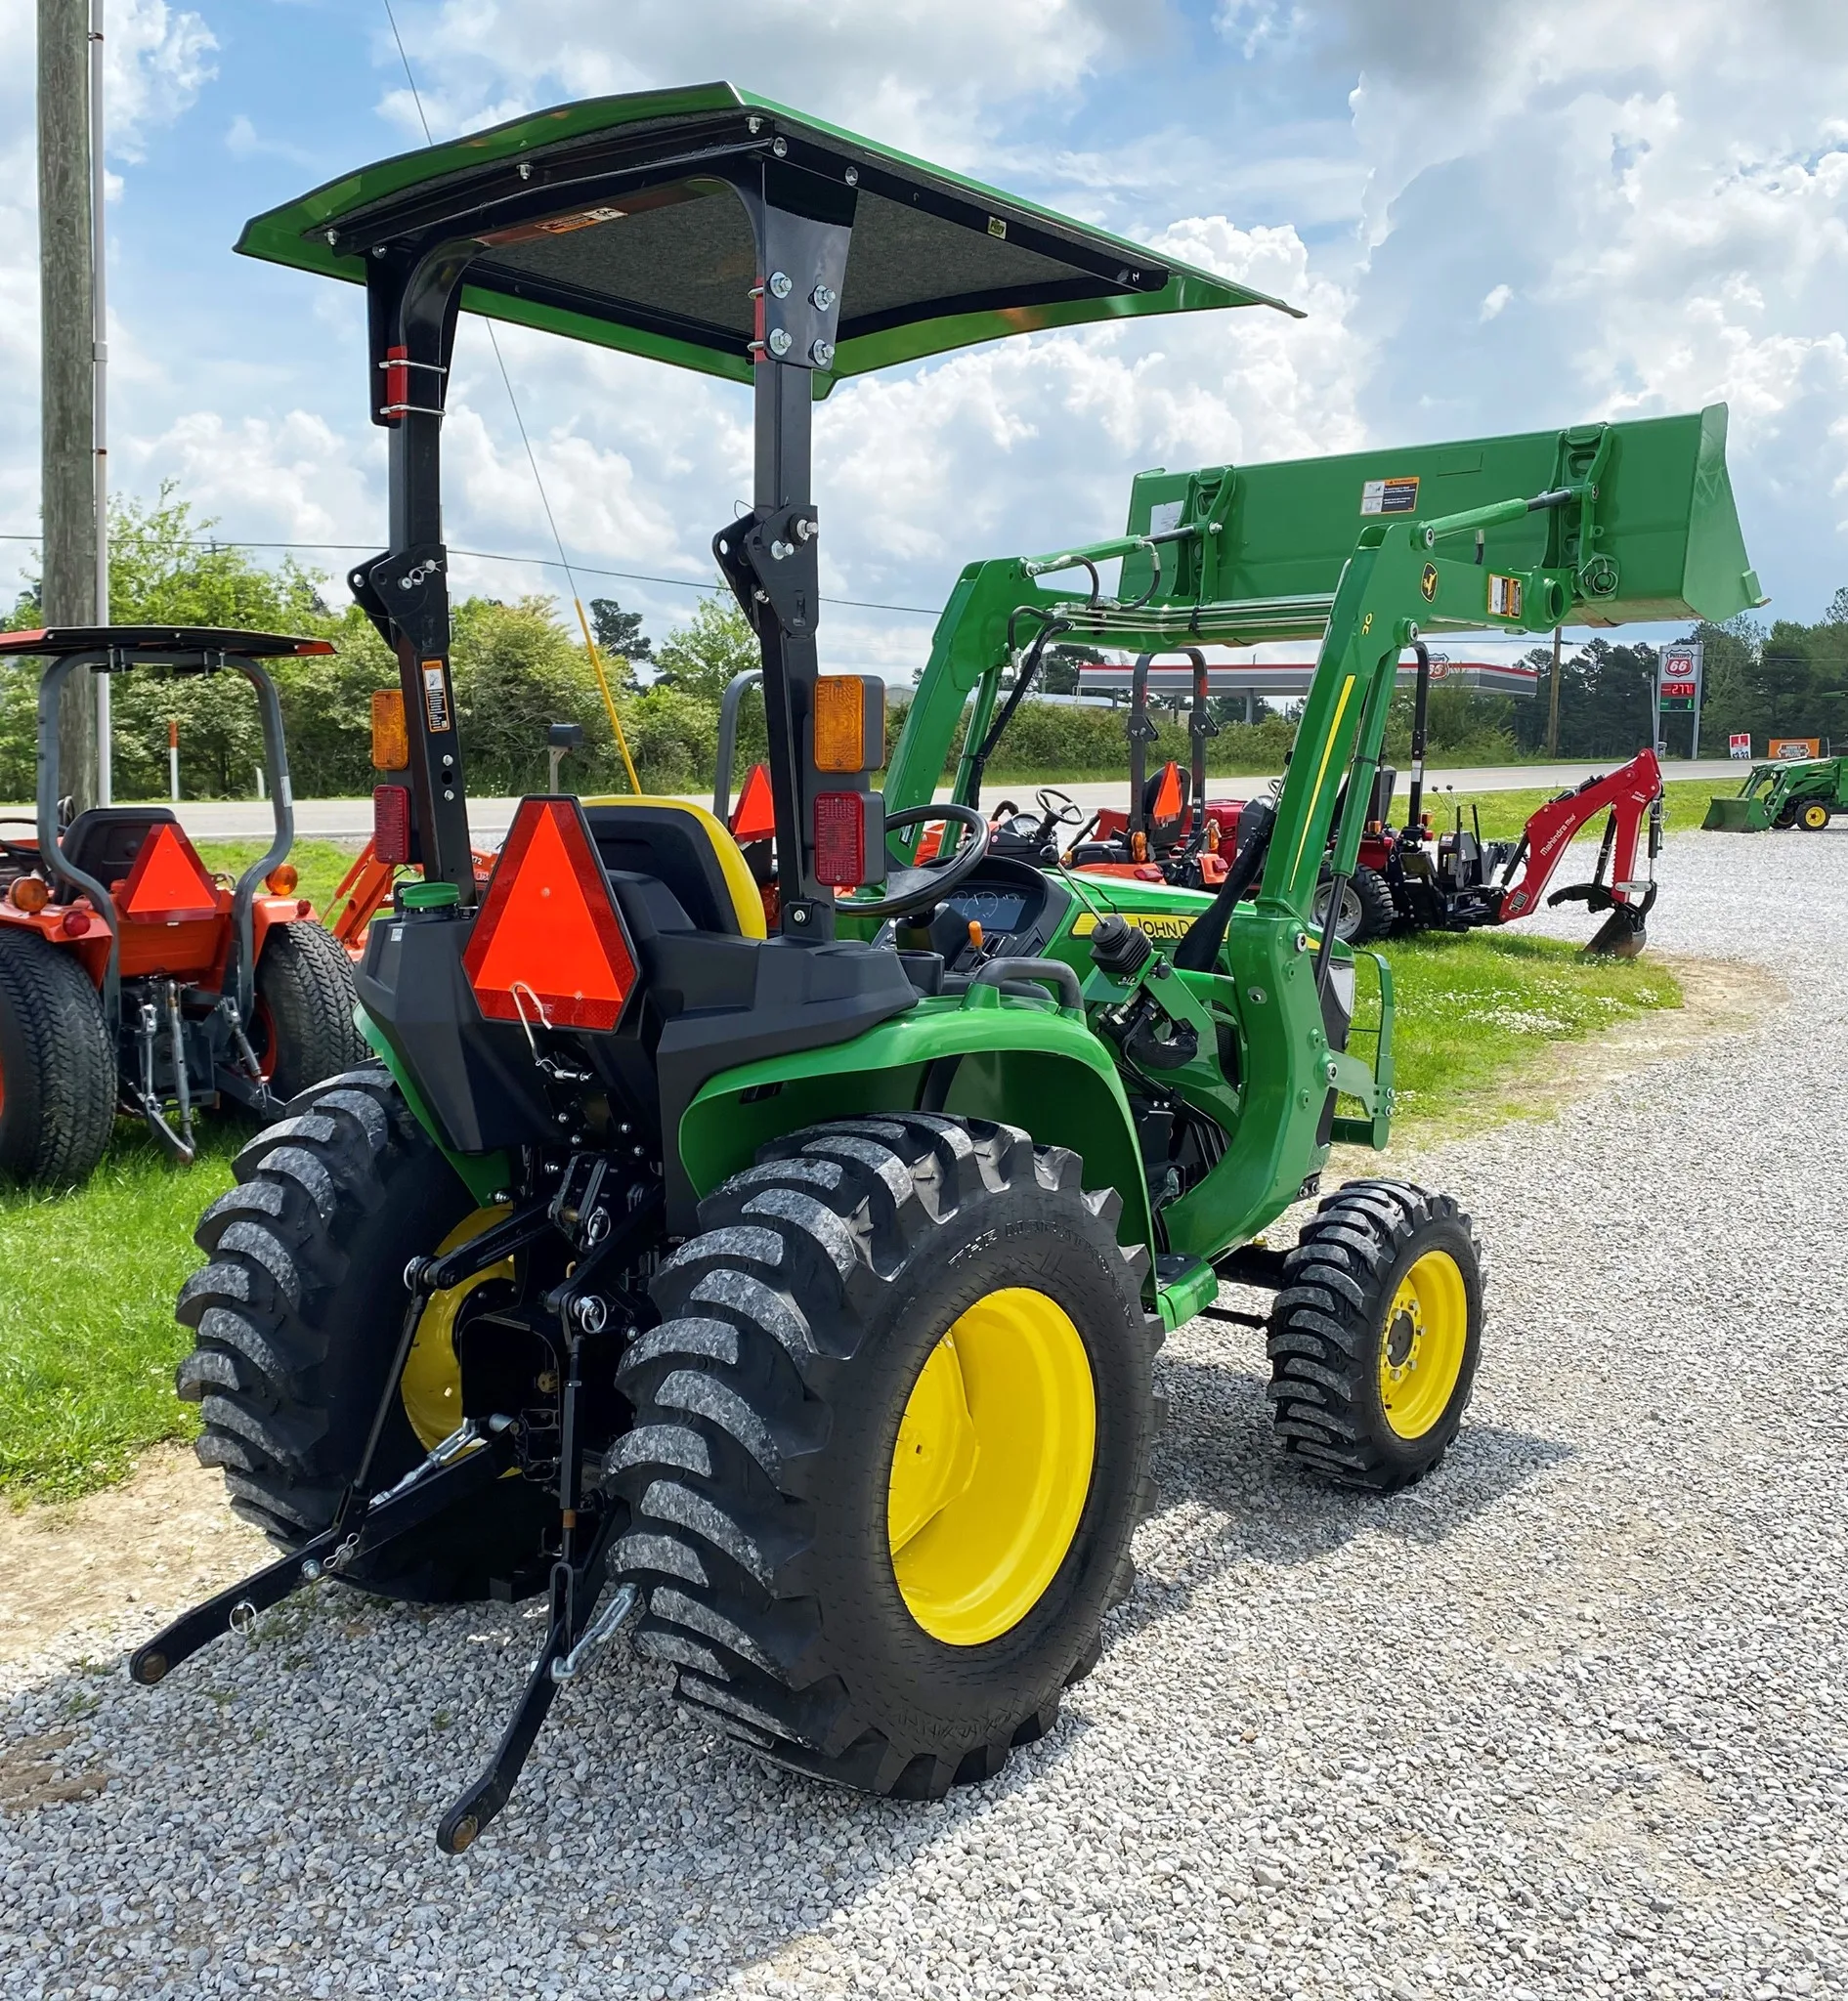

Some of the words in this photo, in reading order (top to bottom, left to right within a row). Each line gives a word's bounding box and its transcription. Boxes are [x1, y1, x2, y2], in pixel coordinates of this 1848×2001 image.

[1669, 660, 1689, 672] 66
[1539, 825, 1568, 856] Mahindra
[1138, 916, 1178, 937] JOHN
[947, 1228, 999, 1269] THE
